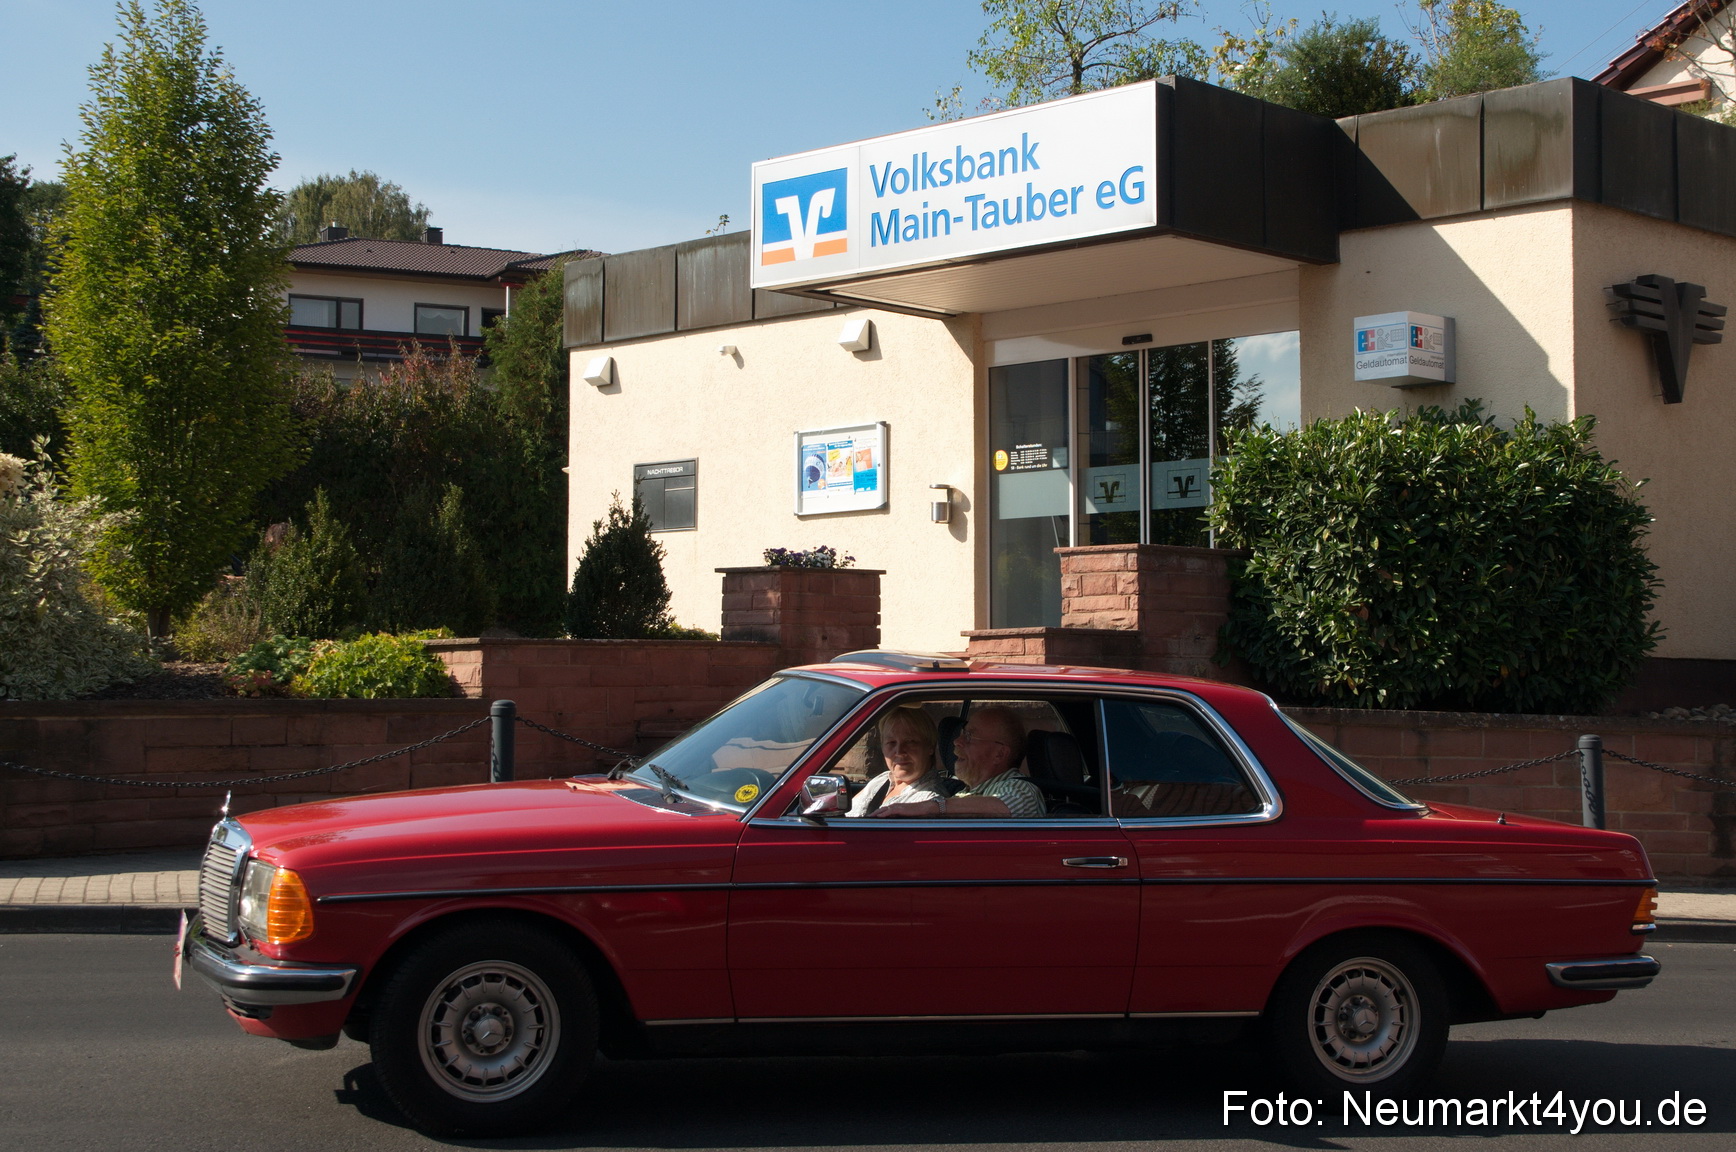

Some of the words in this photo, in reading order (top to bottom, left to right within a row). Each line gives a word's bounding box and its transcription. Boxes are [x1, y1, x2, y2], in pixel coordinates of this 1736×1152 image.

[869, 132, 1040, 199] Volksbank
[871, 182, 1084, 248] Main-Tauber
[1095, 165, 1146, 210] eG
[1356, 356, 1407, 370] Geldautomat
[1409, 355, 1444, 370] Geldautomat
[647, 466, 684, 475] NACHTTRESOR
